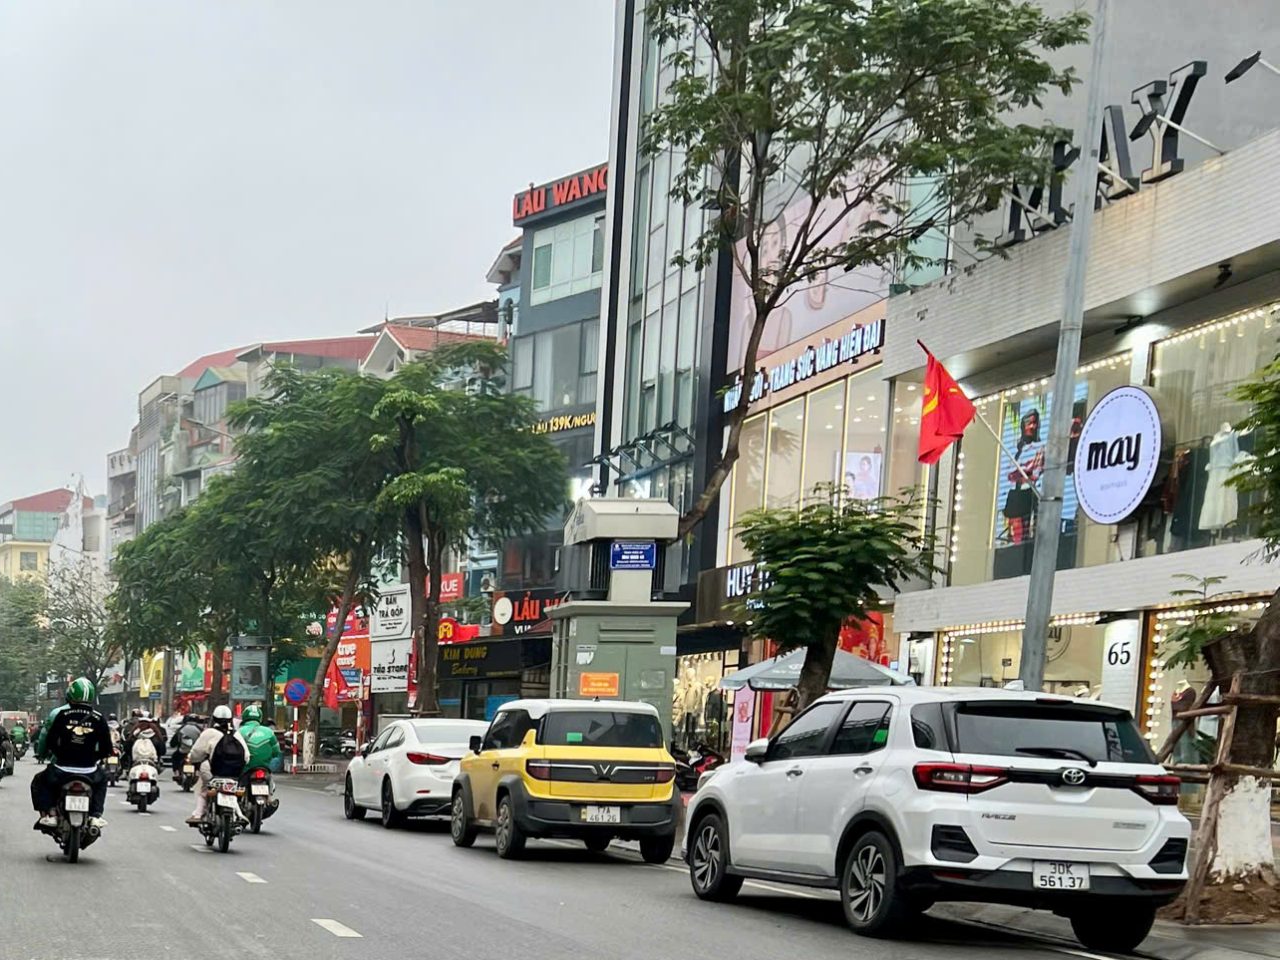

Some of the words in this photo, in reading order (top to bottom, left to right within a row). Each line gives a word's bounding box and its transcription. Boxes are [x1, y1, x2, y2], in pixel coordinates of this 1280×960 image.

[1086, 432, 1142, 471] may
[1108, 641, 1131, 666] 65
[1049, 862, 1074, 876] 30K
[1039, 875, 1084, 889] 561.37
